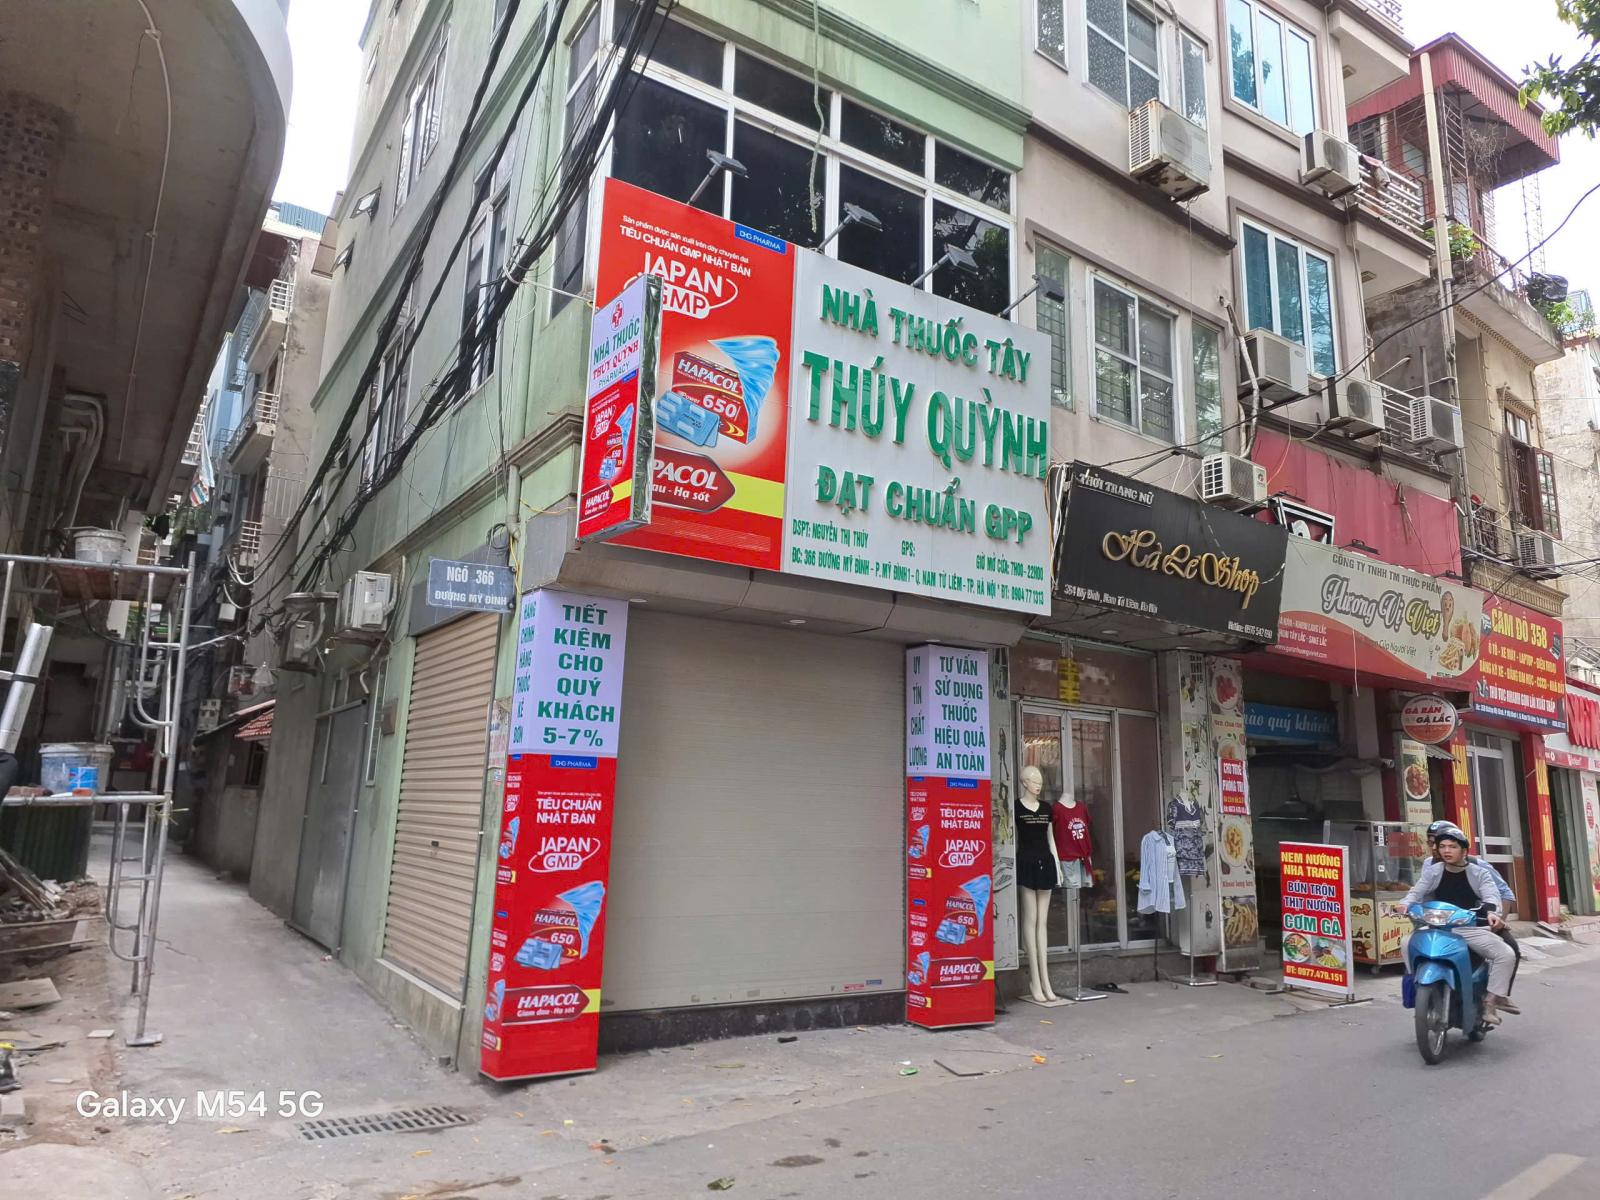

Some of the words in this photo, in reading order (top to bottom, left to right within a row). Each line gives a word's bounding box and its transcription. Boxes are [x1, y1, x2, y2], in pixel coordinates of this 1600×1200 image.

[620, 224, 641, 241] TIÊU
[642, 233, 679, 253] CHUẨN
[680, 245, 702, 258] GMP
[702, 252, 730, 271] NHẬT
[753, 234, 781, 251] PHARMA
[593, 337, 610, 366] NHÀ
[612, 315, 640, 351] THUỐC
[820, 284, 879, 336] NHÀ
[889, 307, 979, 367] THUỐC
[984, 337, 1031, 383] TÂY
[677, 359, 741, 394] HAPACOL
[703, 394, 738, 420] 650
[802, 350, 916, 445] THÚY
[926, 388, 1048, 480] QUỲNH
[674, 486, 689, 501] Hạ
[693, 487, 711, 503] sốt
[1105, 481, 1138, 499] TRANG
[1139, 491, 1154, 505] NỮ
[815, 464, 875, 516] ĐẠT
[885, 476, 976, 534] CHUẨN
[984, 504, 1033, 544] GPP
[840, 528, 851, 548] THỊ
[901, 540, 916, 557] GPS:
[447, 565, 469, 582] NGÕ
[476, 570, 495, 586] 366
[792, 546, 803, 563] ĐC:
[804, 549, 816, 566] 366
[818, 549, 840, 570] ĐƯỜNG
[855, 554, 870, 576] ĐÌNH
[922, 570, 936, 587] NAM
[948, 573, 962, 591] LIÊM
[976, 577, 985, 595] HÀ
[1332, 552, 1354, 569] CÔNG
[1356, 559, 1366, 573] TY
[1368, 563, 1387, 578] TNHH
[1389, 570, 1400, 583] TM
[1402, 573, 1420, 589] THỰC
[1421, 577, 1442, 594] PHẨM
[485, 594, 507, 606] ĐÌNH
[1321, 574, 1377, 627] Hương
[1378, 589, 1404, 632] Vị
[1404, 597, 1442, 640] Việt
[562, 603, 608, 625] TIẾT
[1491, 607, 1514, 638] CẦM
[1515, 612, 1529, 643] ĐỒ
[1530, 623, 1547, 649] 358
[554, 628, 611, 651] KIỆM
[558, 652, 604, 672] CHO
[913, 656, 921, 675] UY
[940, 656, 953, 674] TƯ
[956, 654, 978, 676] VẤN
[557, 677, 601, 697] QUÝ
[913, 683, 922, 705] TÍN
[935, 675, 951, 697] SỬ
[954, 682, 983, 702] DỤNG
[537, 700, 614, 723] KHÁCH
[942, 701, 977, 723] THUỐC
[1404, 706, 1419, 715] GÀ
[1420, 705, 1442, 715] RÁN
[1416, 715, 1431, 724] GÀ
[1432, 712, 1452, 723] LẮC
[1268, 713, 1291, 732] quý
[543, 727, 603, 747] 5-7%
[934, 726, 960, 749] HIỆU
[964, 726, 986, 748] QUẢ
[936, 753, 952, 769] AN
[956, 751, 985, 771] TOÀN
[536, 797, 560, 810] TIÊU
[562, 796, 602, 811] CHUẨN
[940, 808, 956, 818] TIÊU
[957, 807, 984, 819] CHUẨN
[536, 812, 570, 825] NHẬT
[571, 811, 596, 824] BẢN
[941, 820, 963, 830] NHẬT
[537, 837, 591, 855] JAPAN
[944, 839, 979, 854] JAPAN
[545, 855, 581, 868] GMP
[950, 854, 973, 865] GMP
[1281, 851, 1303, 864] NEM
[1305, 852, 1341, 868] NƯỚNG
[1283, 864, 1304, 876] NHA
[1307, 866, 1339, 880] TRANG
[1287, 880, 1307, 892] BÚN
[1285, 896, 1304, 910] THỊT
[1306, 896, 1340, 913] NƯỚNG
[534, 913, 578, 927] HAPACOL
[957, 915, 974, 925] 650
[1284, 914, 1317, 932] CƠM
[1320, 916, 1342, 936] GÀ
[551, 933, 574, 945] 650
[940, 963, 981, 976] HAPACOL
[517, 993, 580, 1009] HAPACOL
